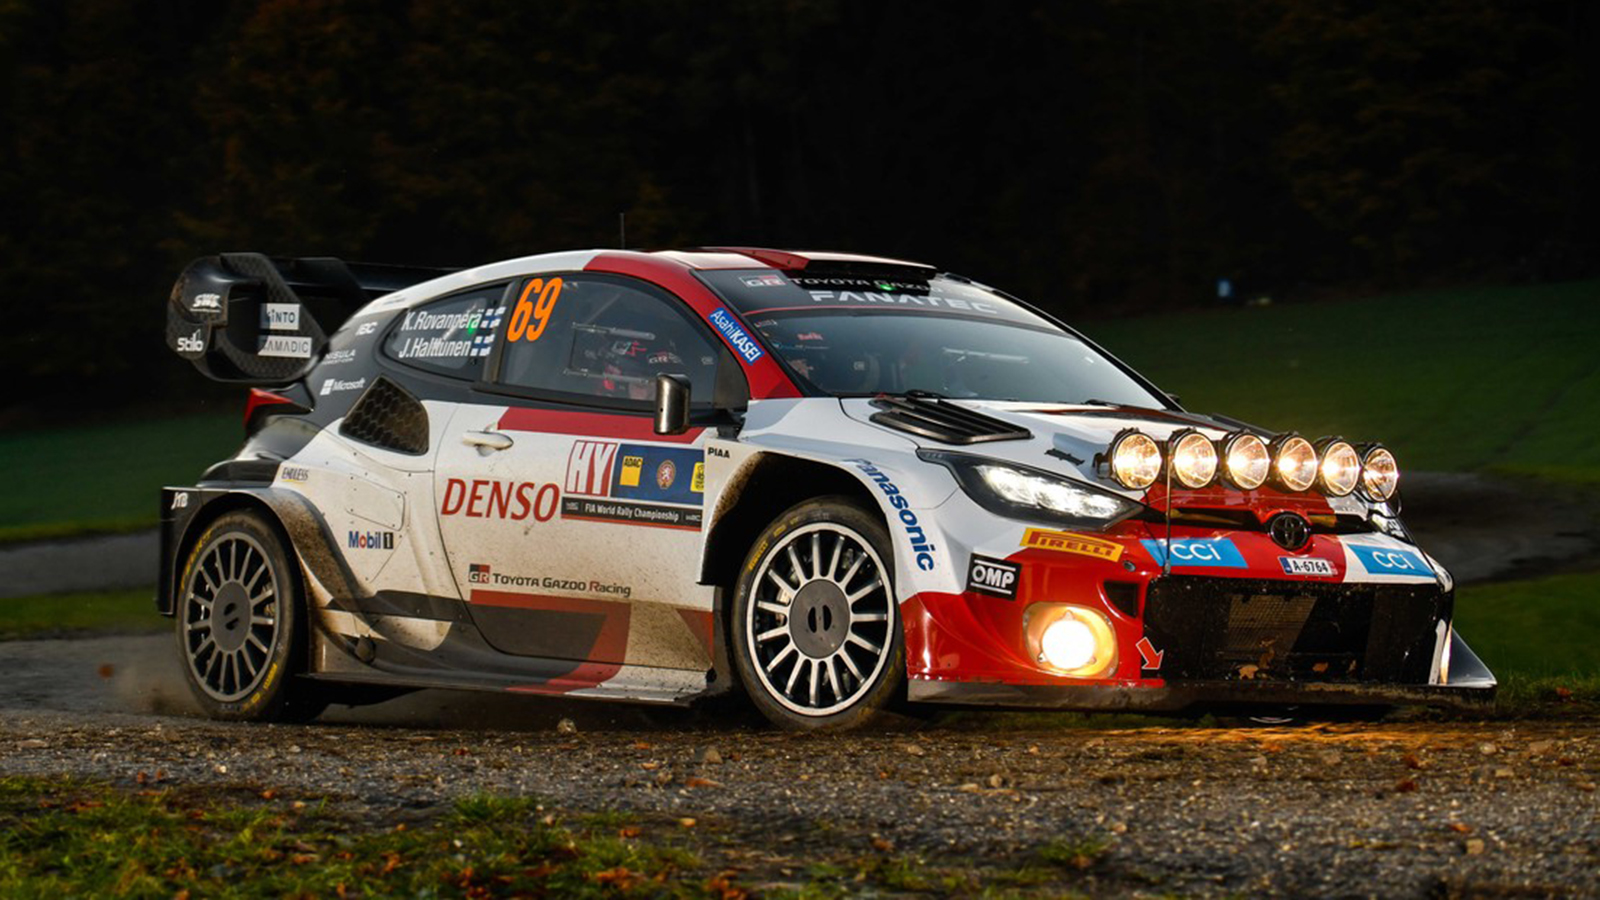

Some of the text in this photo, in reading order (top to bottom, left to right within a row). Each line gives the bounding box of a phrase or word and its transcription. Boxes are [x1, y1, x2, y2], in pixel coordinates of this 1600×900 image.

[789, 278, 871, 286] TOYOTA
[507, 277, 563, 342] 69
[809, 290, 997, 314] FANATEC
[398, 337, 472, 358] J.Halttunen
[332, 377, 366, 391] Microsoft
[624, 457, 642, 468] ADAC
[707, 447, 731, 459] PIAA
[566, 440, 616, 496] HY
[441, 478, 560, 522] DENSO
[585, 503, 596, 513] FIA
[597, 504, 616, 515] World
[616, 506, 633, 518] Rally
[634, 508, 680, 522] Championship
[348, 530, 381, 549] Mobil
[1027, 530, 1117, 557] PIRELLI
[972, 565, 1015, 588] OMP
[1292, 560, 1329, 573] A-6764
[492, 573, 540, 587] TOYOTA
[542, 577, 587, 592] GAZOO
[589, 580, 632, 598] Racing
